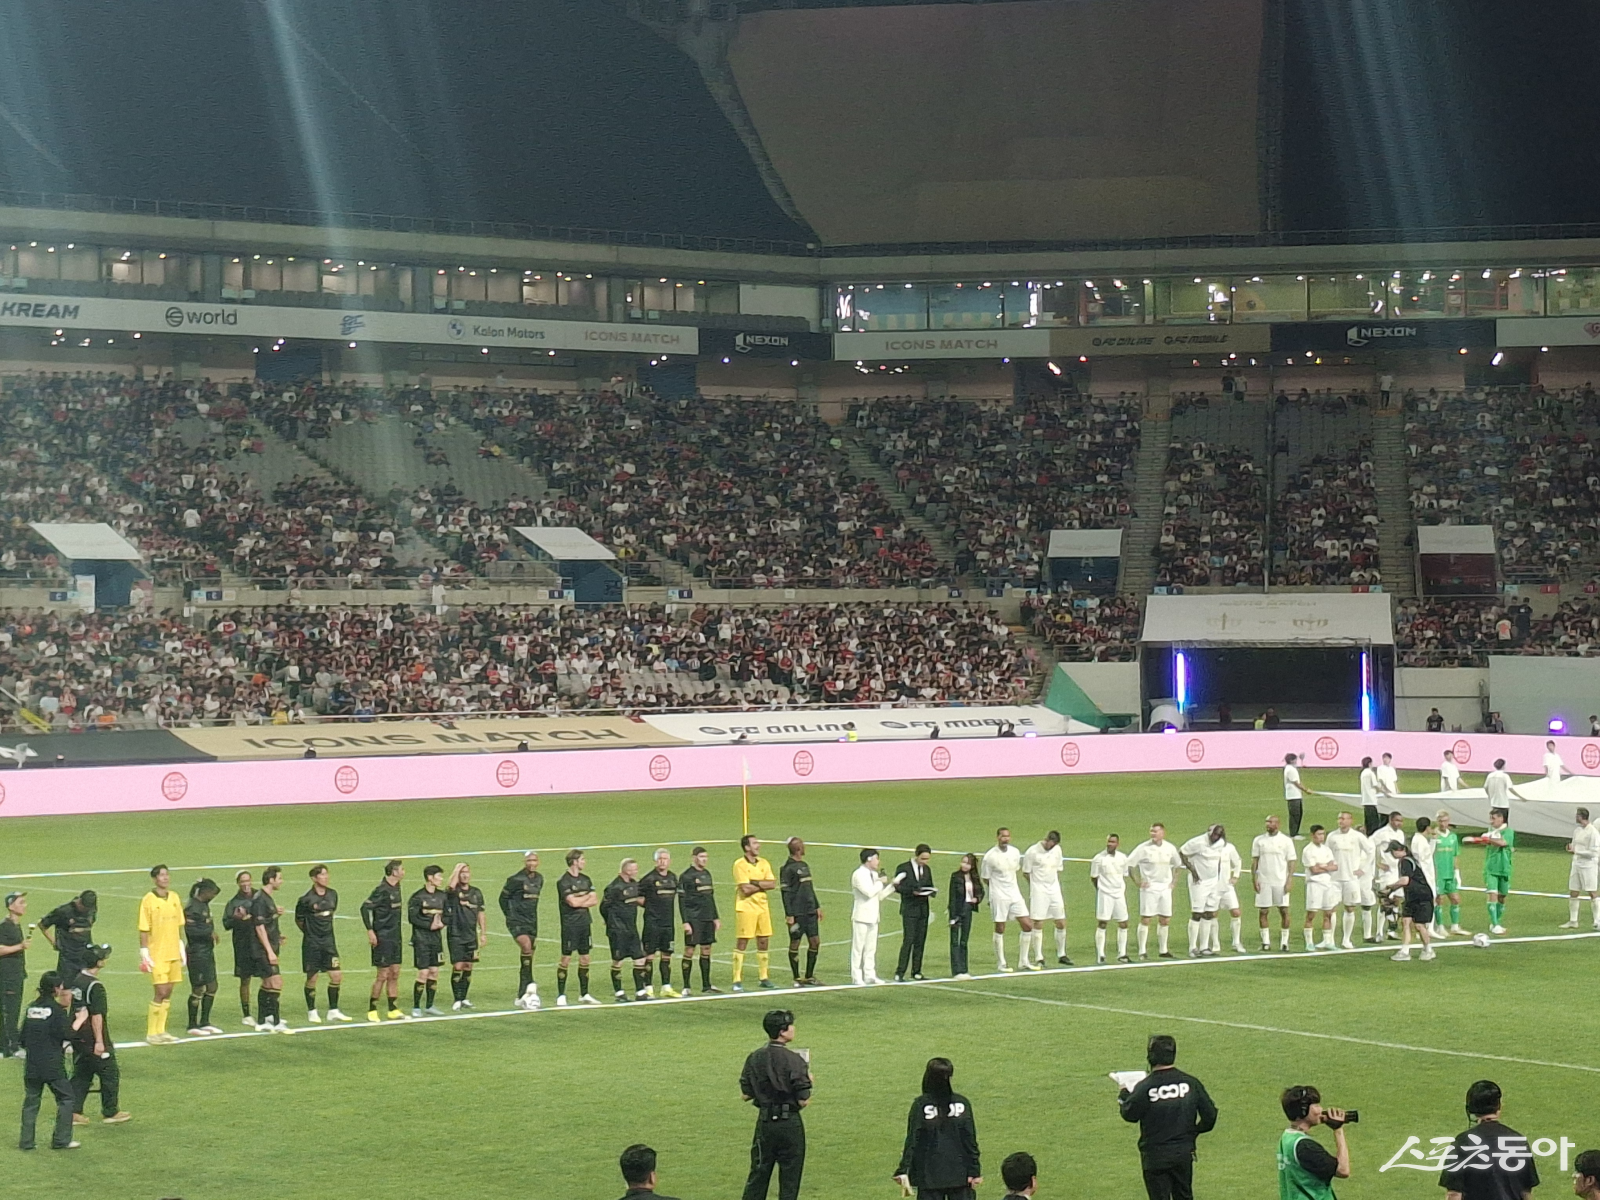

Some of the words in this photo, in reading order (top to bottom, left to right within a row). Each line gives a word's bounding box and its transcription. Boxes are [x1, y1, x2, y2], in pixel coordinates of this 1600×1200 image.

[1, 301, 80, 319] KREAM
[186, 308, 237, 325] world
[507, 327, 546, 339] Motors
[585, 329, 628, 342] ICONS
[630, 331, 680, 344] MATCH
[1361, 326, 1417, 338] NEXON
[746, 334, 789, 346] NEXON
[885, 340, 936, 351] ICONS
[940, 338, 998, 350] MATCH
[728, 726, 760, 735] FC
[909, 721, 937, 729] FC
[242, 734, 426, 749] ICONS
[432, 729, 627, 744] MATCH
